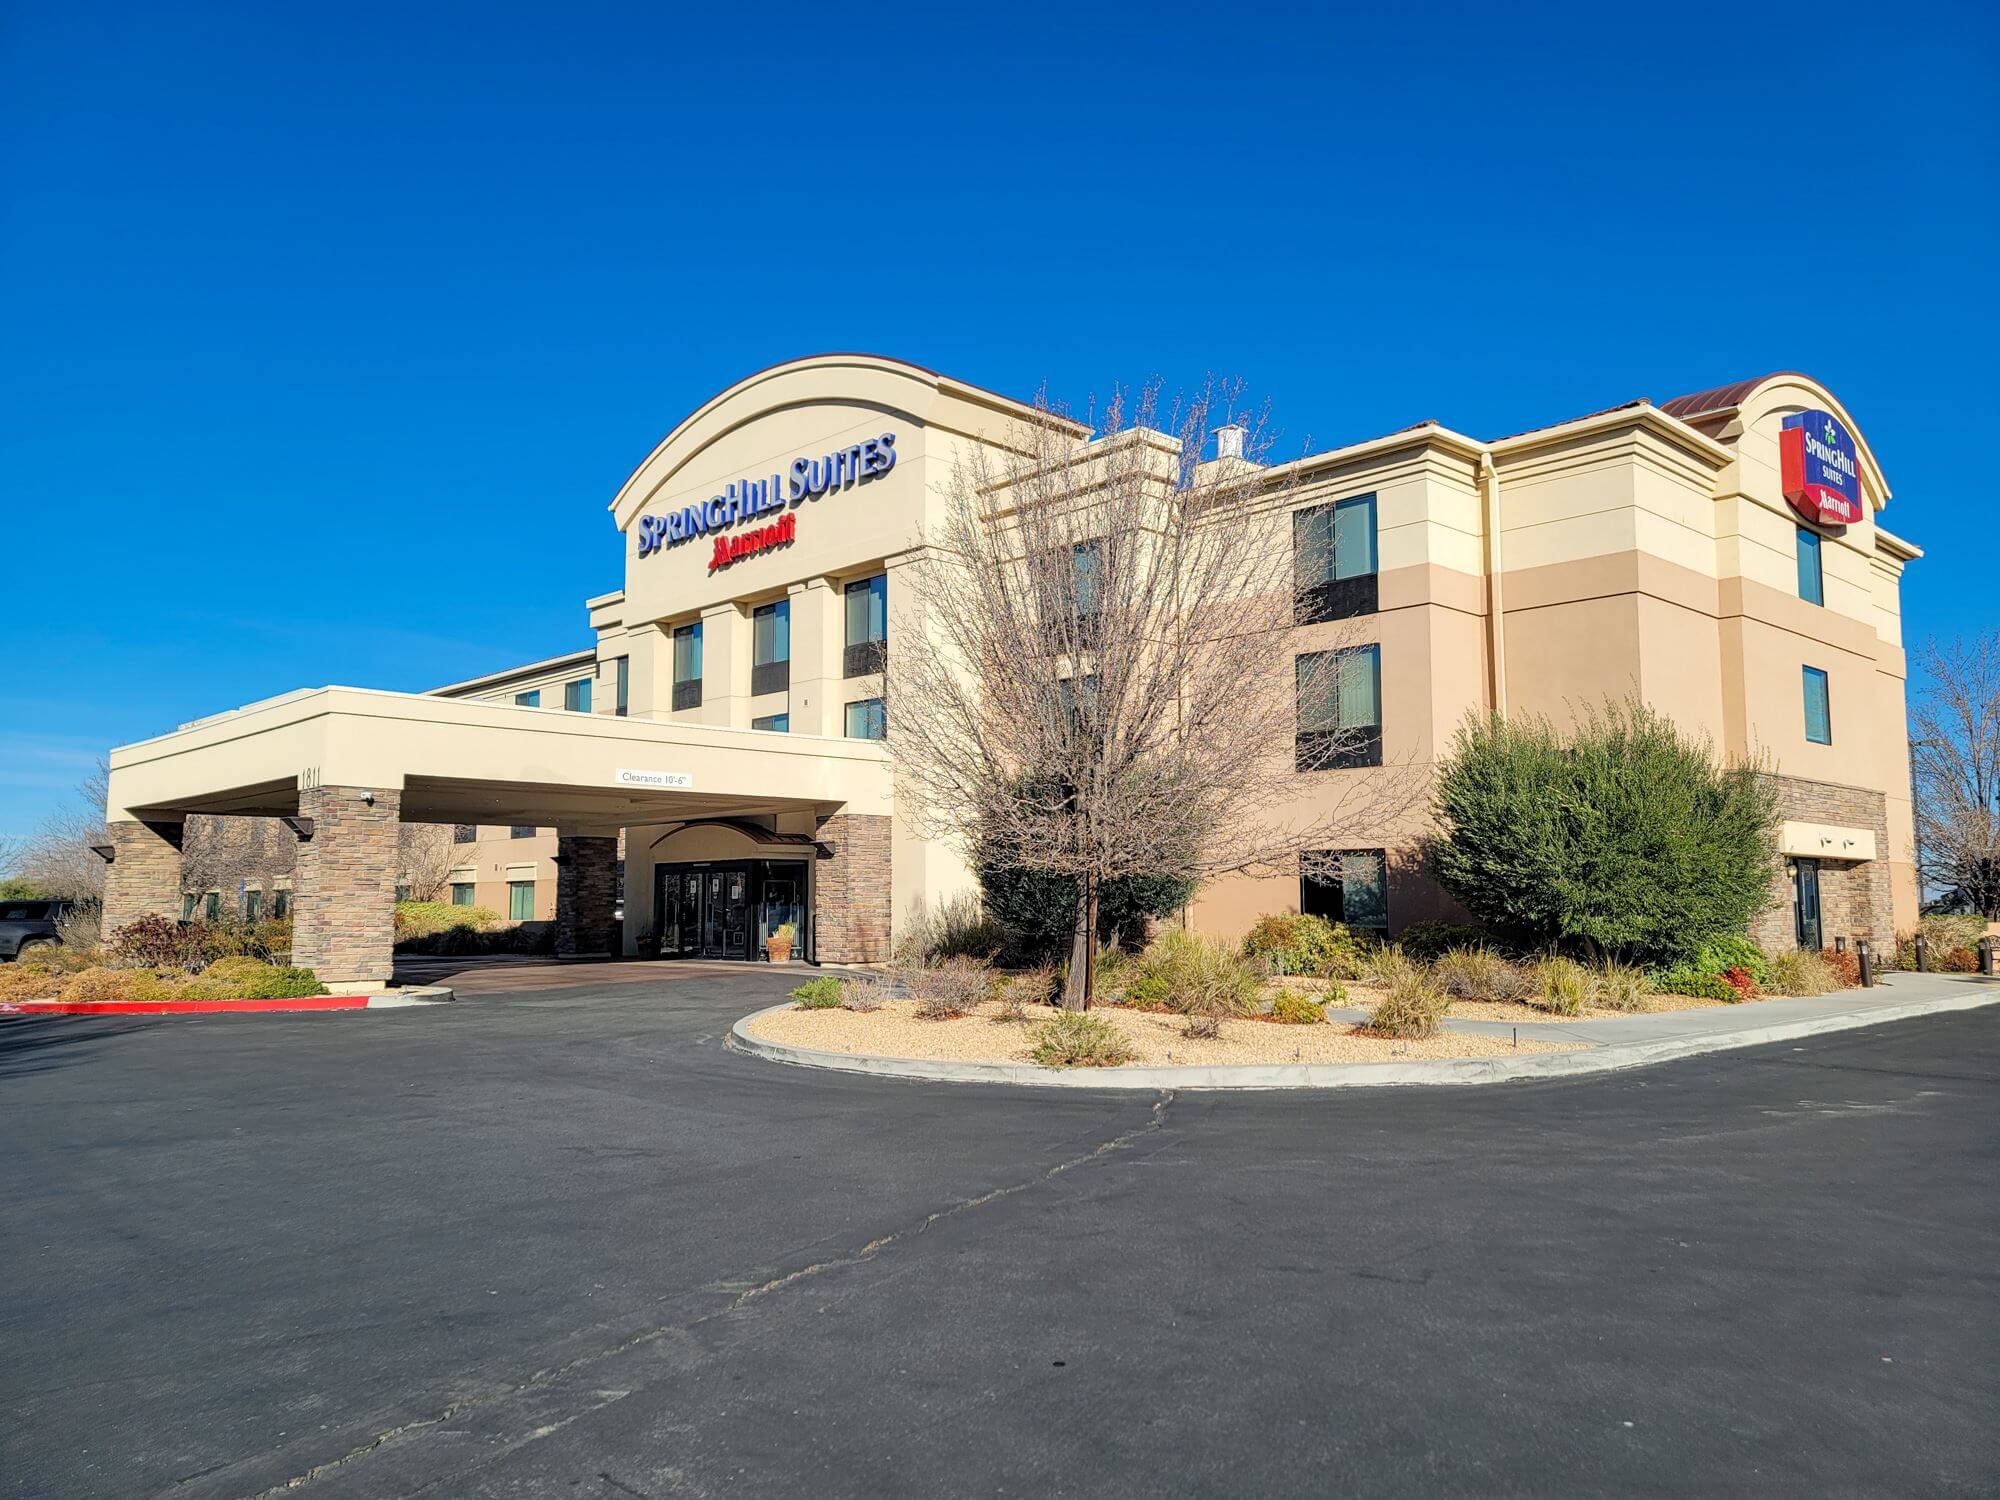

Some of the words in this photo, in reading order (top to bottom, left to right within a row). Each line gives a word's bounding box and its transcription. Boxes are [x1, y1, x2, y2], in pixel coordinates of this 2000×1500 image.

[1805, 431, 1856, 478] SPRINGHILL
[1822, 465, 1843, 485] SUITES
[638, 474, 787, 553] SPRINGHILL
[790, 432, 896, 502] SUITES
[1819, 489, 1850, 518] Marriott
[708, 512, 796, 569] Marriott
[302, 766, 320, 789] 1811
[622, 772, 662, 784] Clearance
